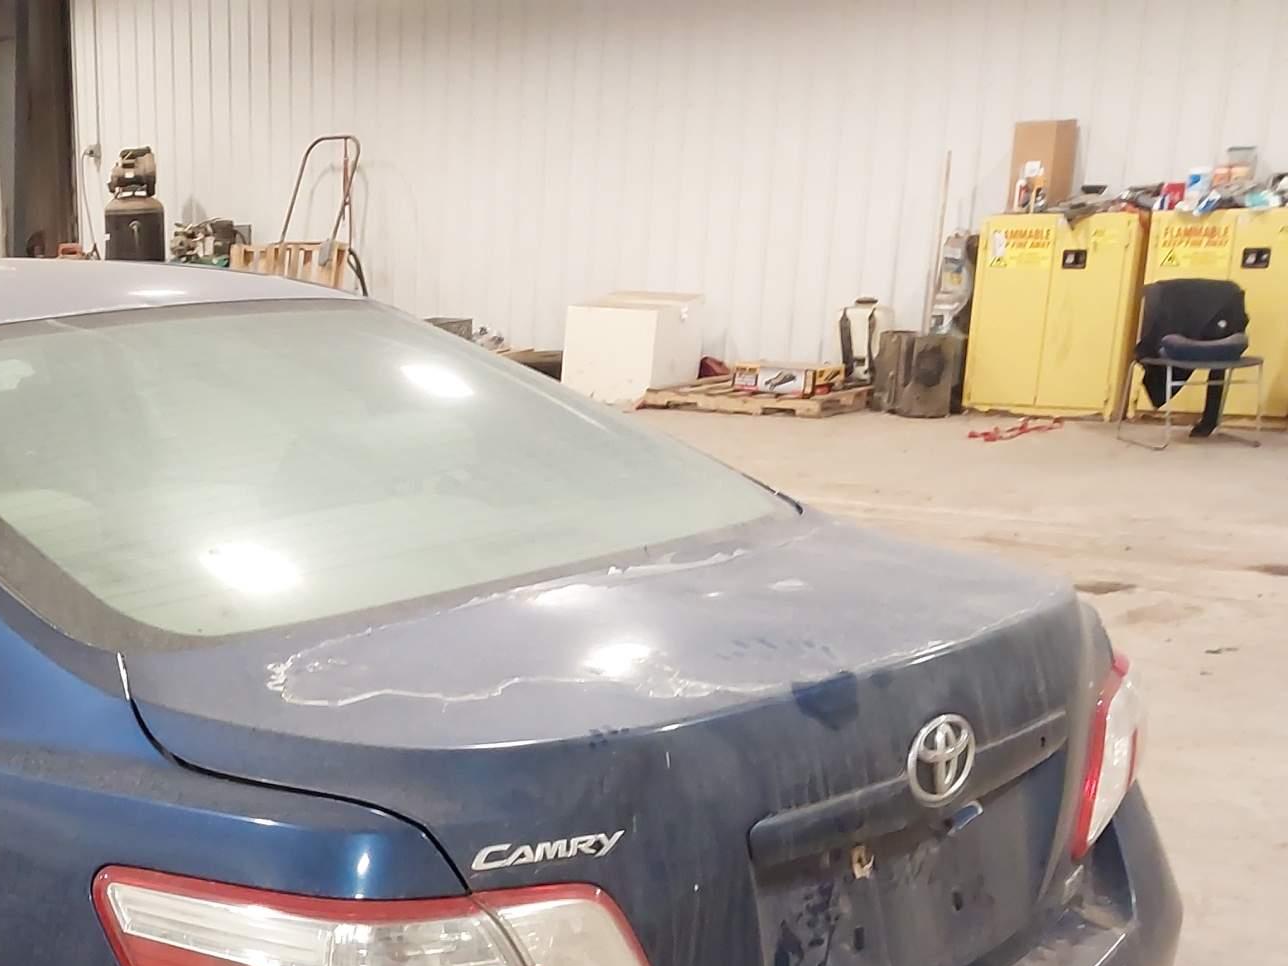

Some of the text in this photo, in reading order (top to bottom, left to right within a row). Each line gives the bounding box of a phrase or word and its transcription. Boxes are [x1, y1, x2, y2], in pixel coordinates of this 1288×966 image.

[993, 228, 1051, 240] AMMABLE
[1162, 225, 1230, 239] FLAMMABLE
[471, 829, 625, 871] CAMRY
